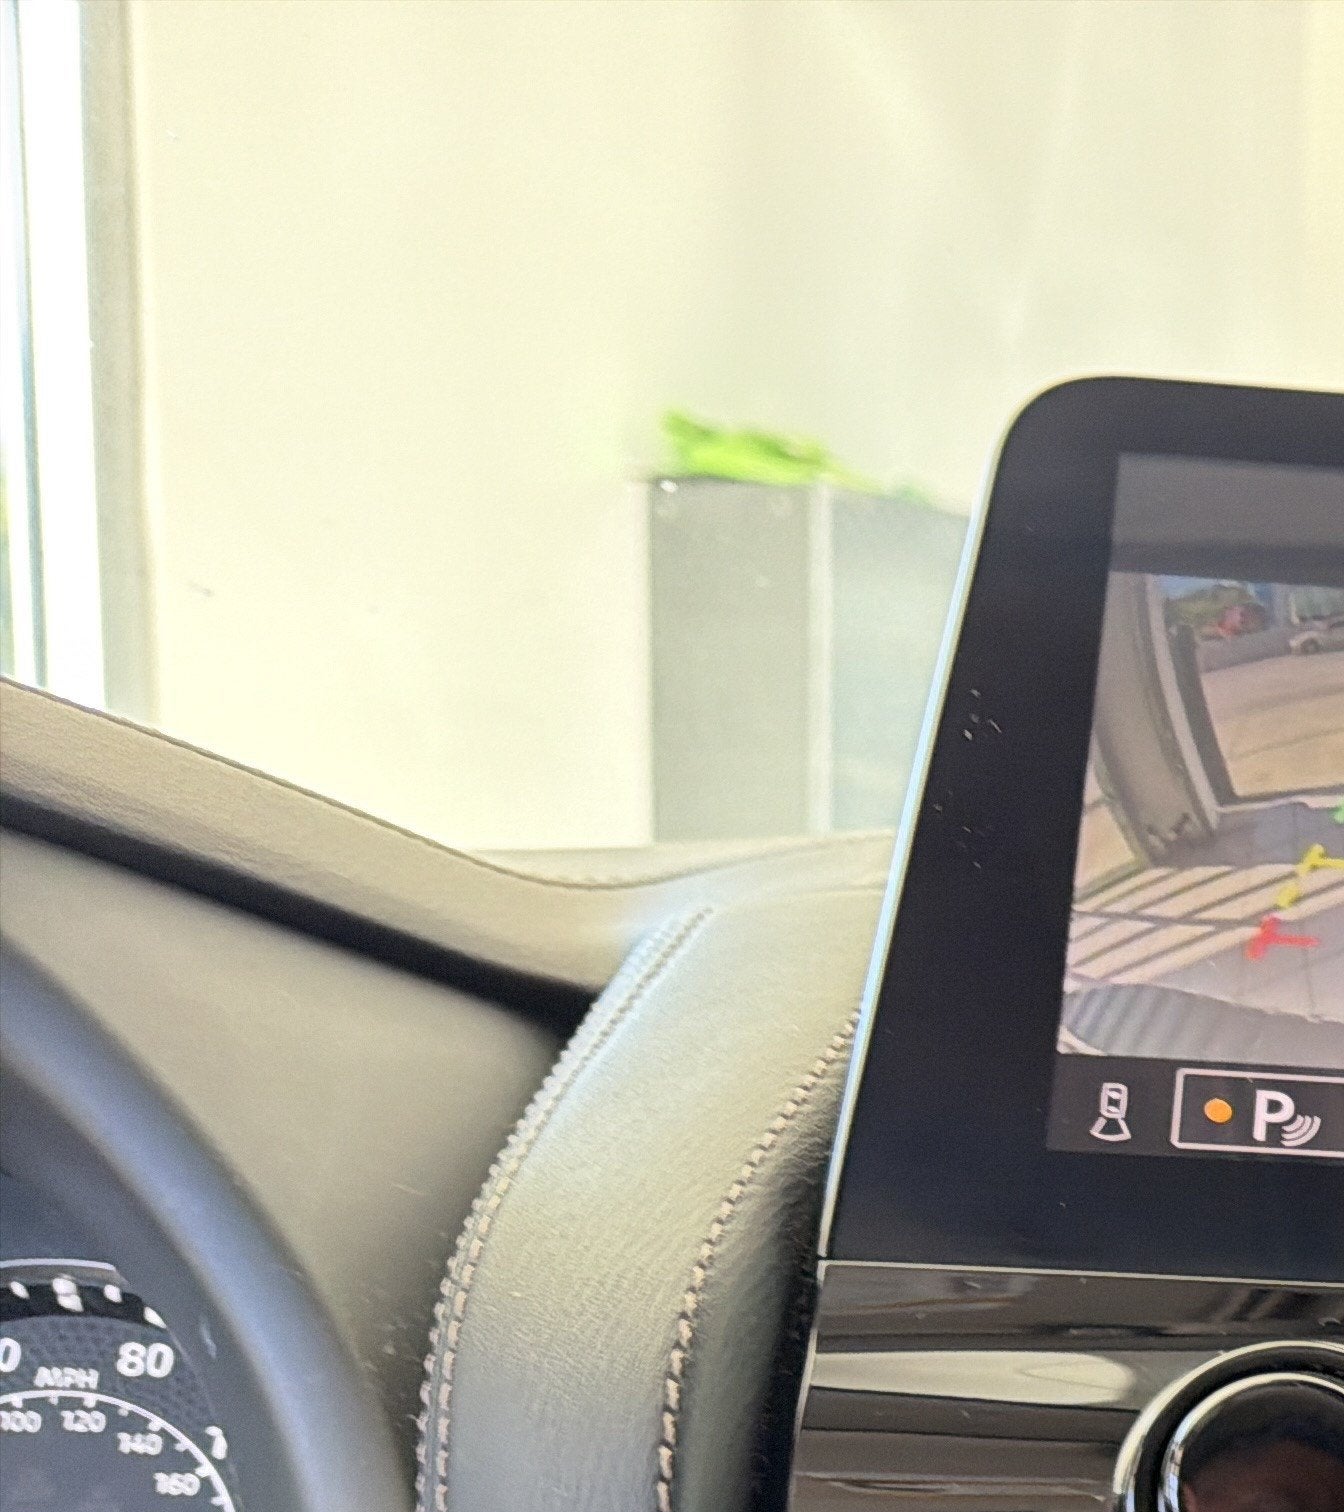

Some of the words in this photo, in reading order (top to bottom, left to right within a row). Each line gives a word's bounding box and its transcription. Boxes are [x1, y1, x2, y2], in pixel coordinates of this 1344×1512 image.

[116, 1341, 174, 1378] 80
[61, 1409, 107, 1433] 120
[116, 1432, 163, 1456] 140
[152, 1472, 201, 1497] 160
